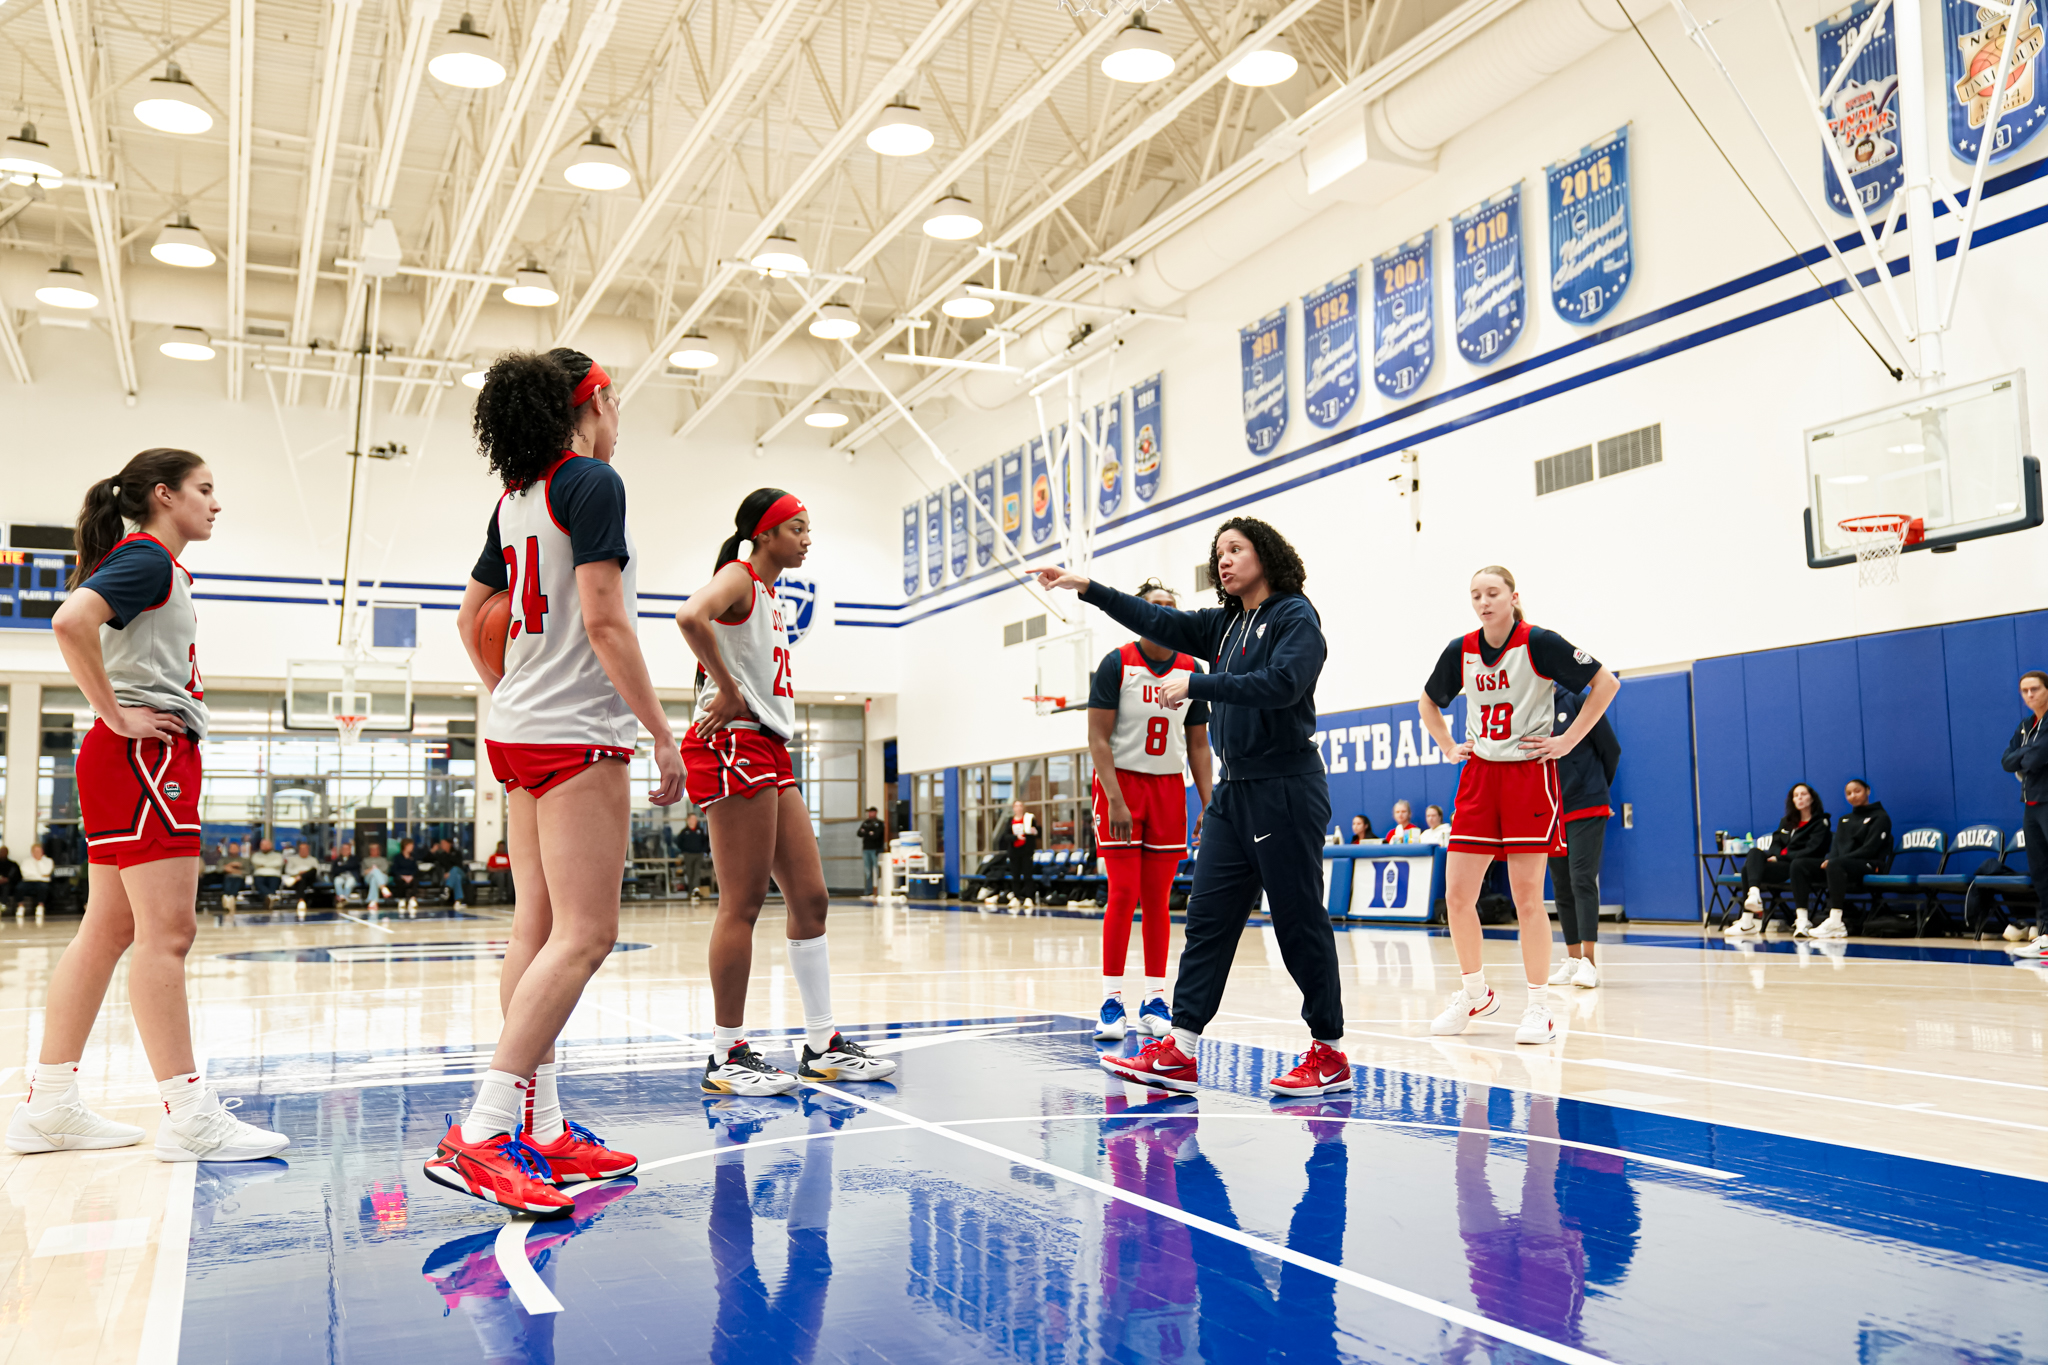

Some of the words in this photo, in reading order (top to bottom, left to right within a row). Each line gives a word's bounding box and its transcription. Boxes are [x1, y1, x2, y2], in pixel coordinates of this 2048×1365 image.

[1970, 23, 2007, 46] NCA
[2011, 37, 2039, 66] OUR
[1828, 105, 1877, 133] FINAL
[1846, 112, 1889, 146] FOUR
[1560, 155, 1613, 207] 2015
[1464, 211, 1509, 255] 2010
[1383, 256, 1426, 294] 2001
[1312, 292, 1350, 329] 1992
[32, 558, 65, 570] PERIOD
[18, 589, 52, 601] PLAYER
[1475, 669, 1511, 692] USA
[1479, 702, 1514, 741] 19
[1144, 716, 1170, 756] 8
[1756, 835, 1774, 851] DU
[1902, 831, 1942, 850] DUKE
[1957, 829, 1998, 849] DUKE
